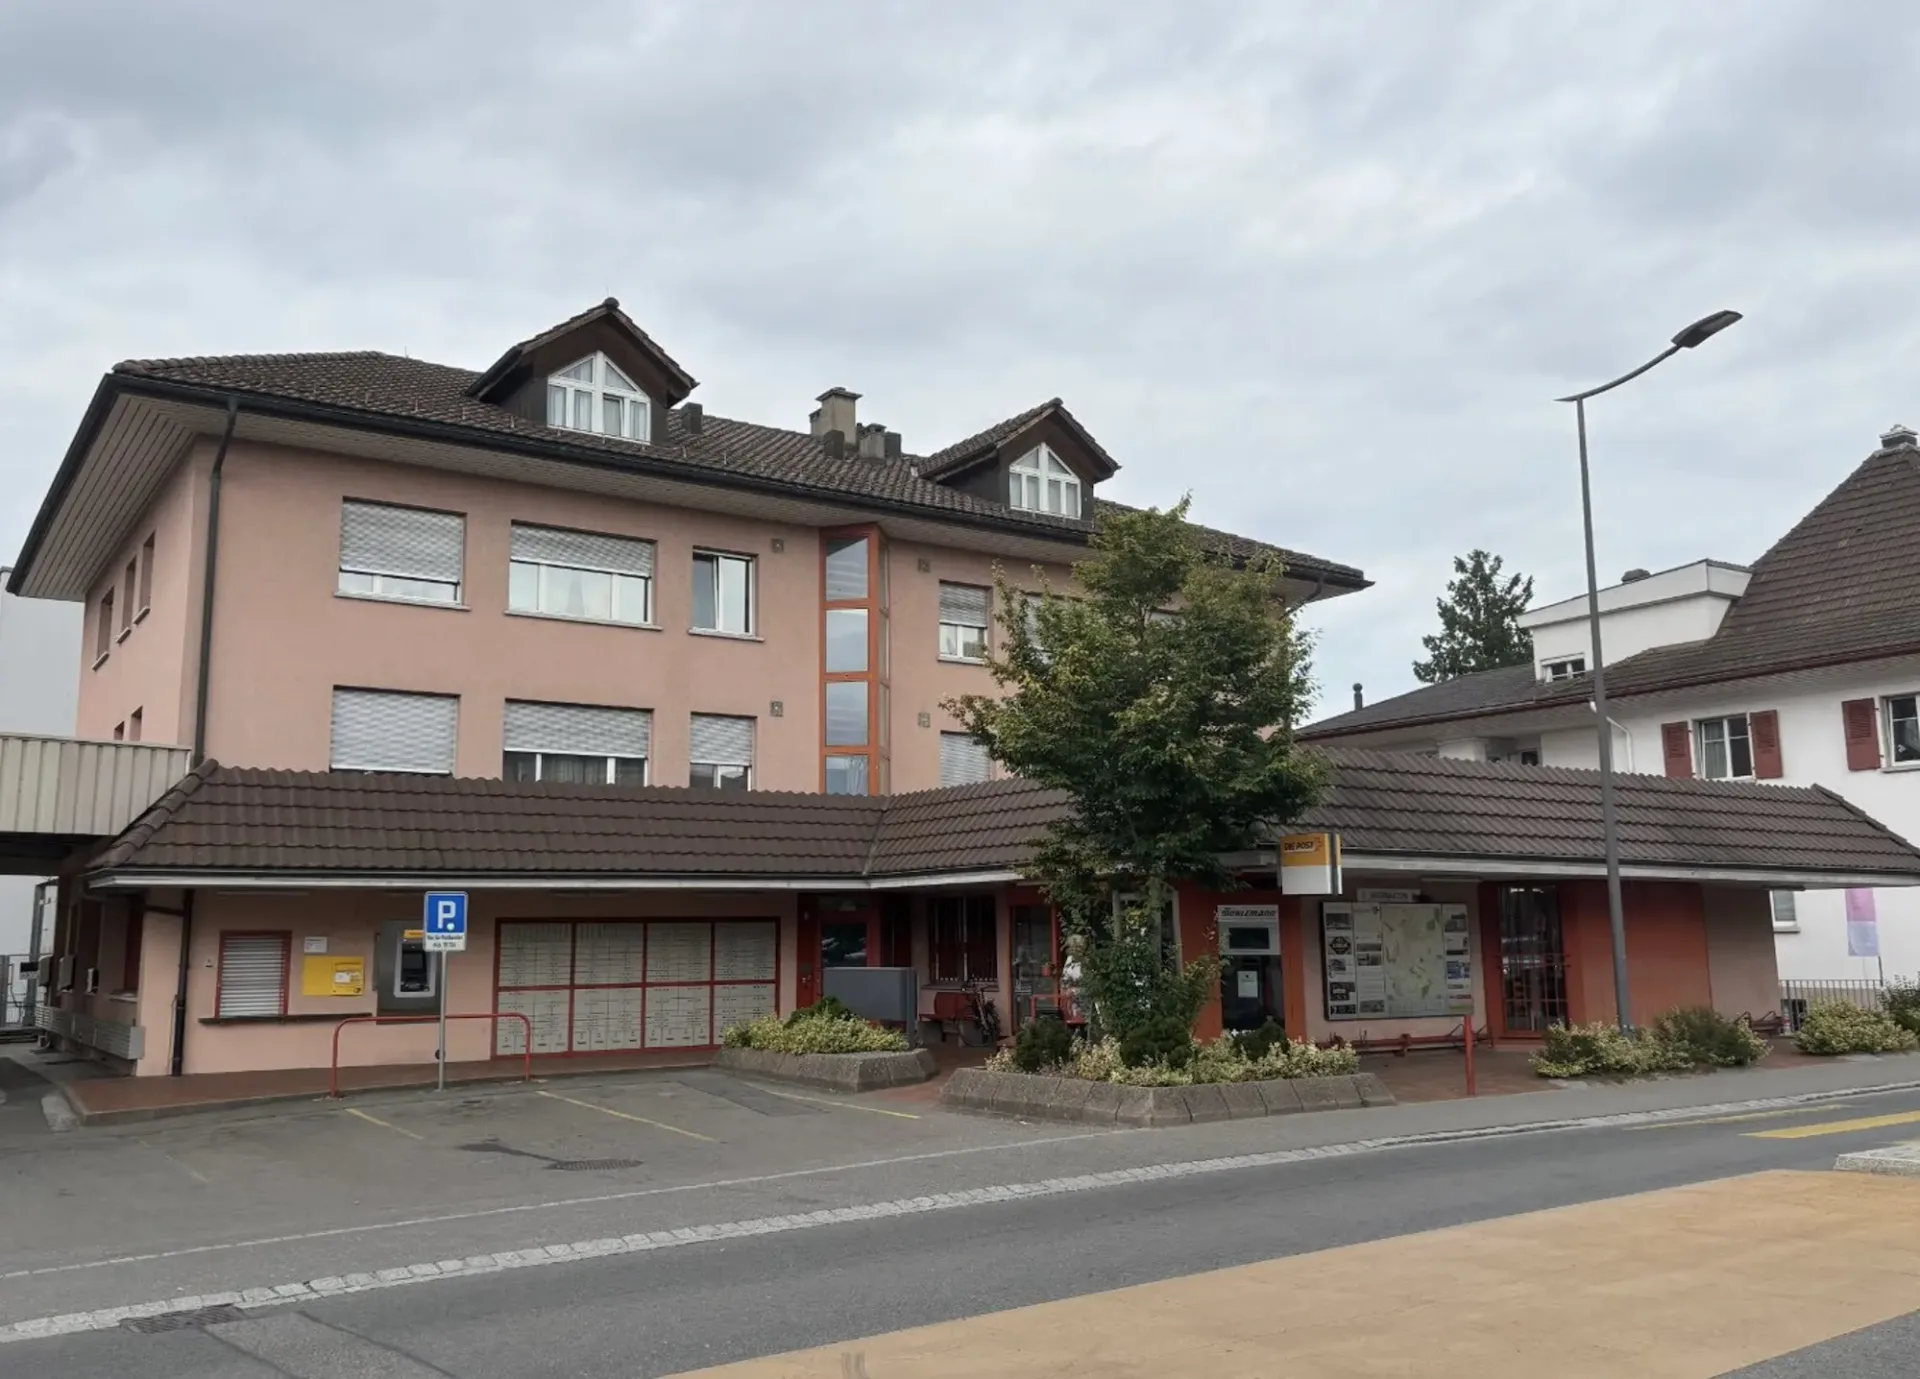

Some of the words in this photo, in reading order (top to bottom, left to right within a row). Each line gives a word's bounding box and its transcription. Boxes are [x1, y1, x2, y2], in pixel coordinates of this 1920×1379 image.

[1284, 842, 1295, 851] DIE
[1296, 841, 1314, 850] POST
[437, 900, 456, 929] P
